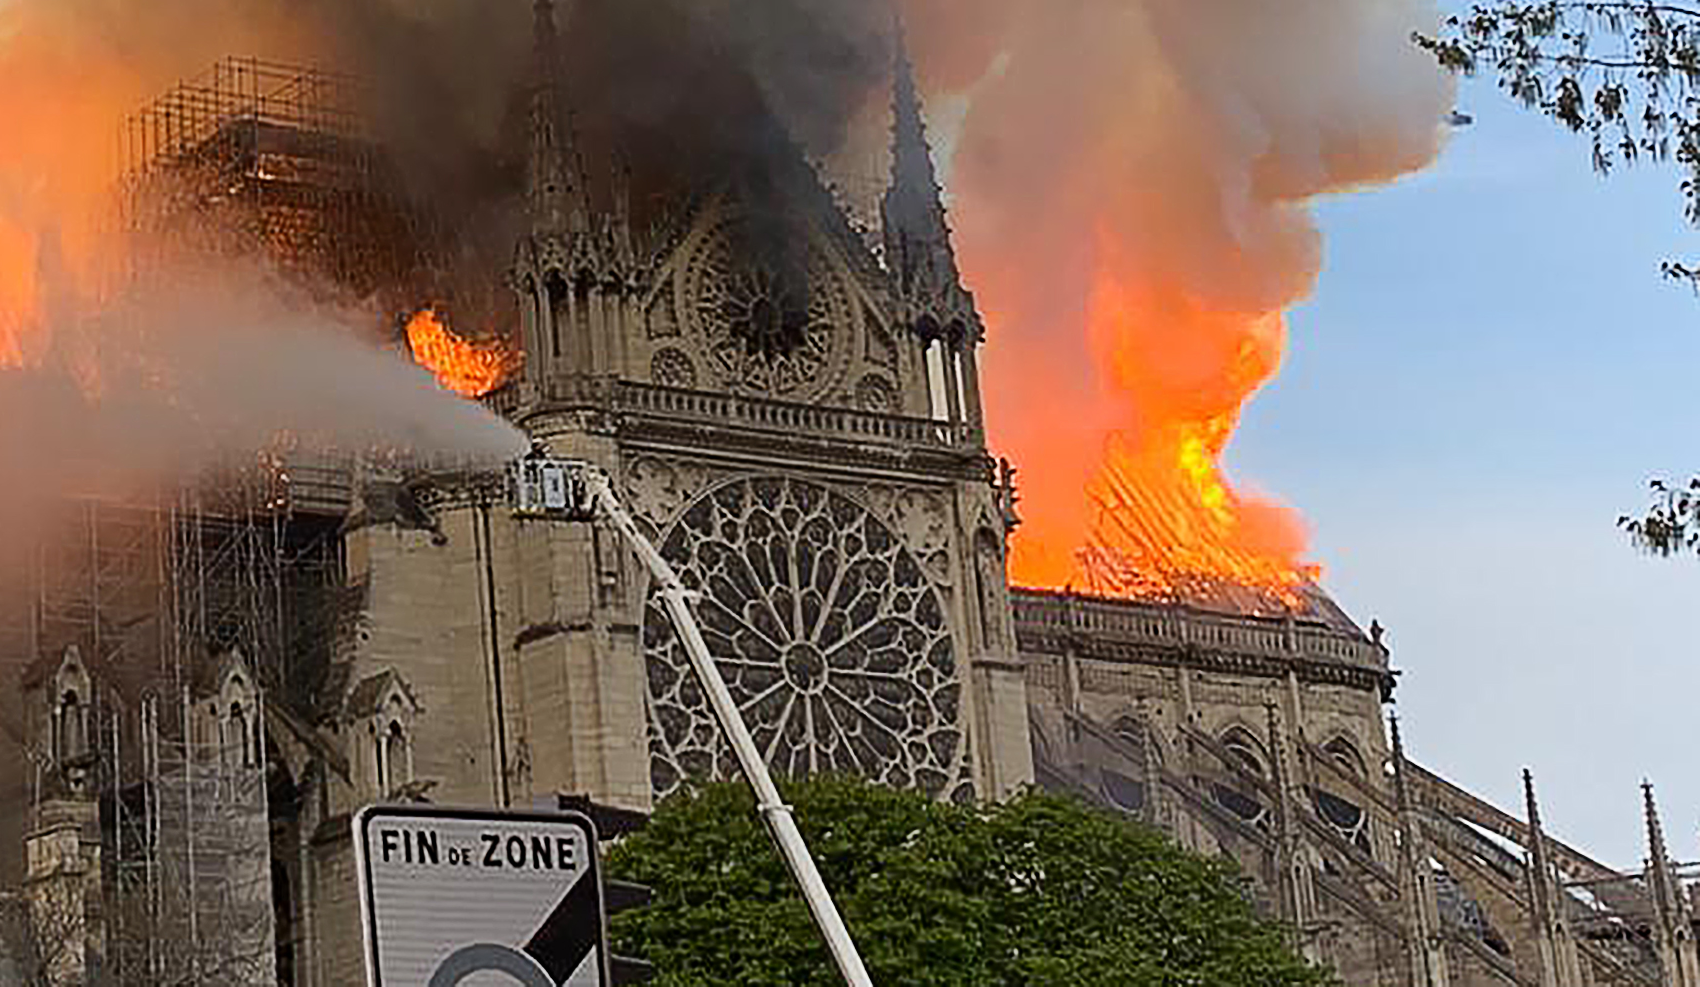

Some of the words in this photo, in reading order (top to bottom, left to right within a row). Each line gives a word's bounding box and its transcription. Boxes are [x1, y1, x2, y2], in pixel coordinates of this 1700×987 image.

[381, 830, 439, 864] FIN
[450, 848, 471, 865] DE
[481, 834, 576, 870] ZONE
